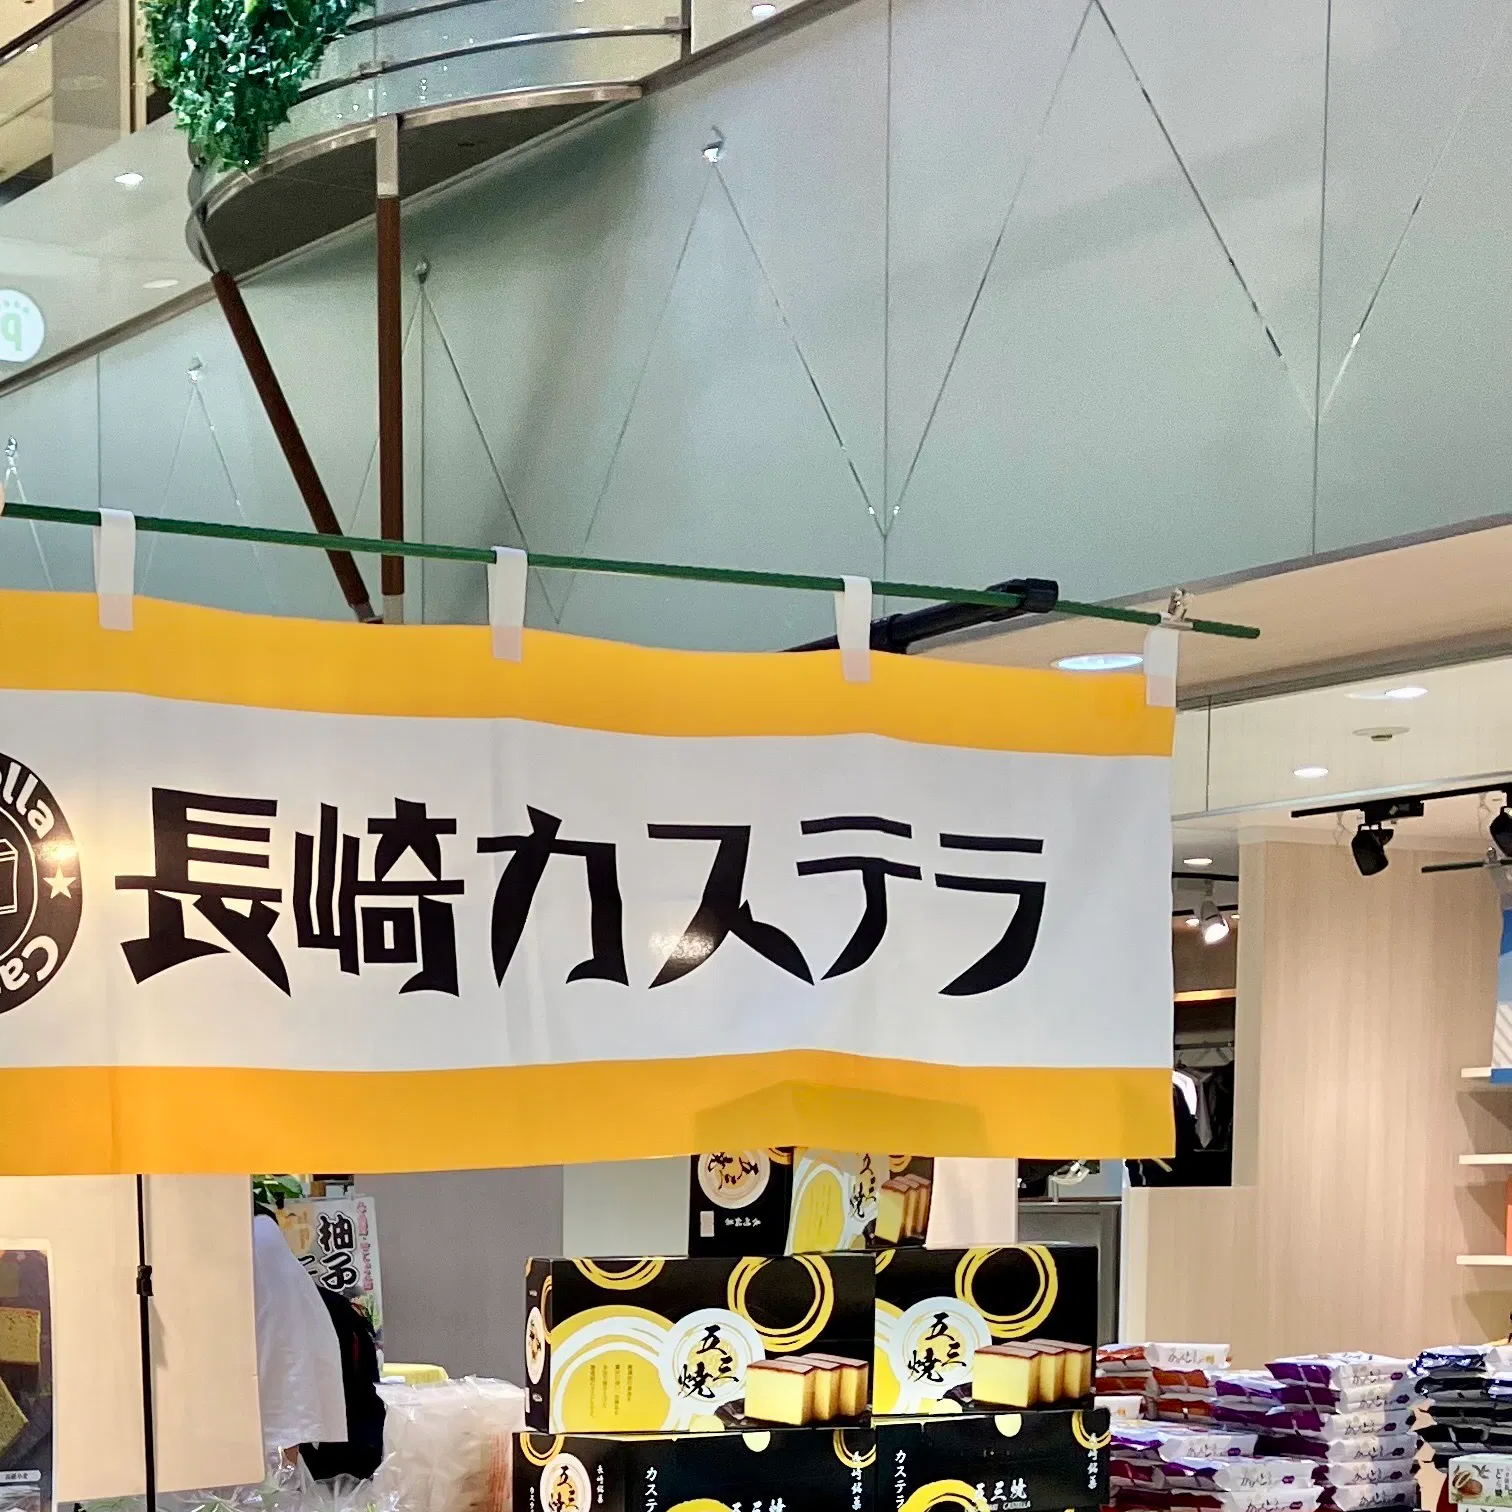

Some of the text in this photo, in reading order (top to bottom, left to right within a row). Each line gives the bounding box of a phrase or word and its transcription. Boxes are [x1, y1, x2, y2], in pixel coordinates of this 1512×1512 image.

[115, 787, 1046, 998] 長崎カステラ
[677, 1324, 740, 1400] 五三焼
[907, 1312, 967, 1383] 五三焼
[894, 1449, 907, 1509] カステラ
